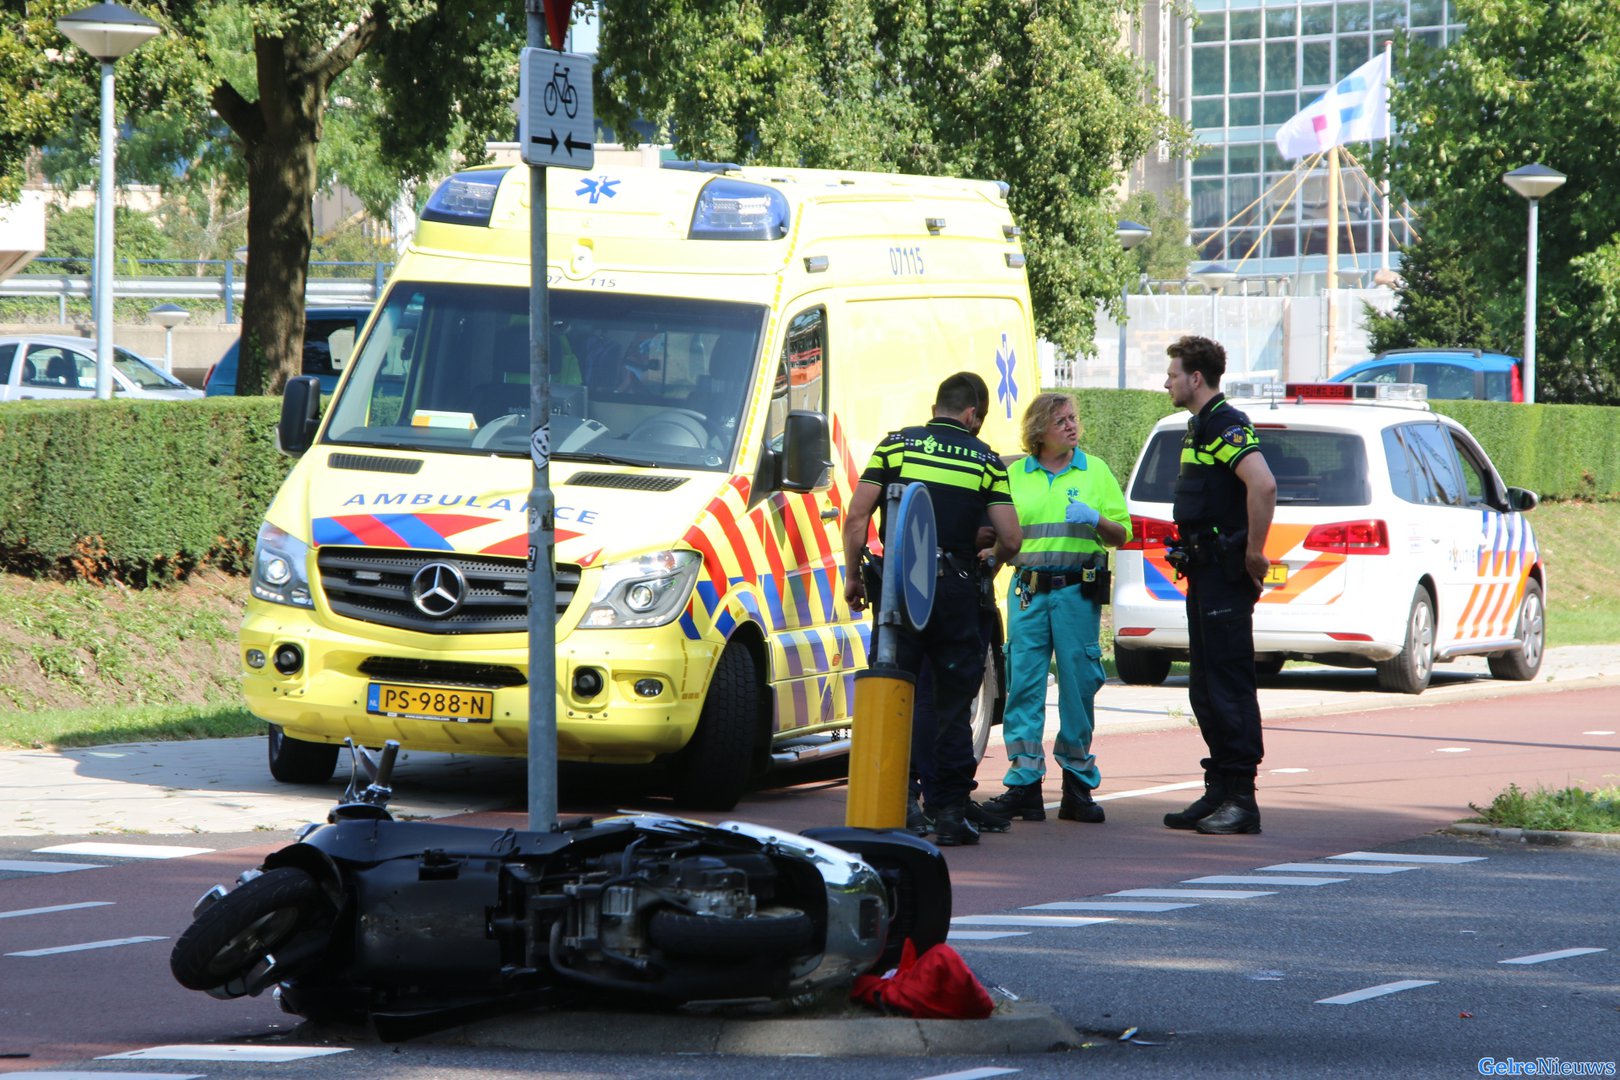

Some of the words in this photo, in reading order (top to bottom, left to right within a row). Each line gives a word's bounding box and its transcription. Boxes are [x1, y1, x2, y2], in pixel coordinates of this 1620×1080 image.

[890, 248, 924, 275] 07115
[590, 278, 616, 287] 115
[914, 435, 978, 458] POLITIE
[341, 493, 599, 525] AMBULACE
[385, 689, 484, 715] PS-988-N
